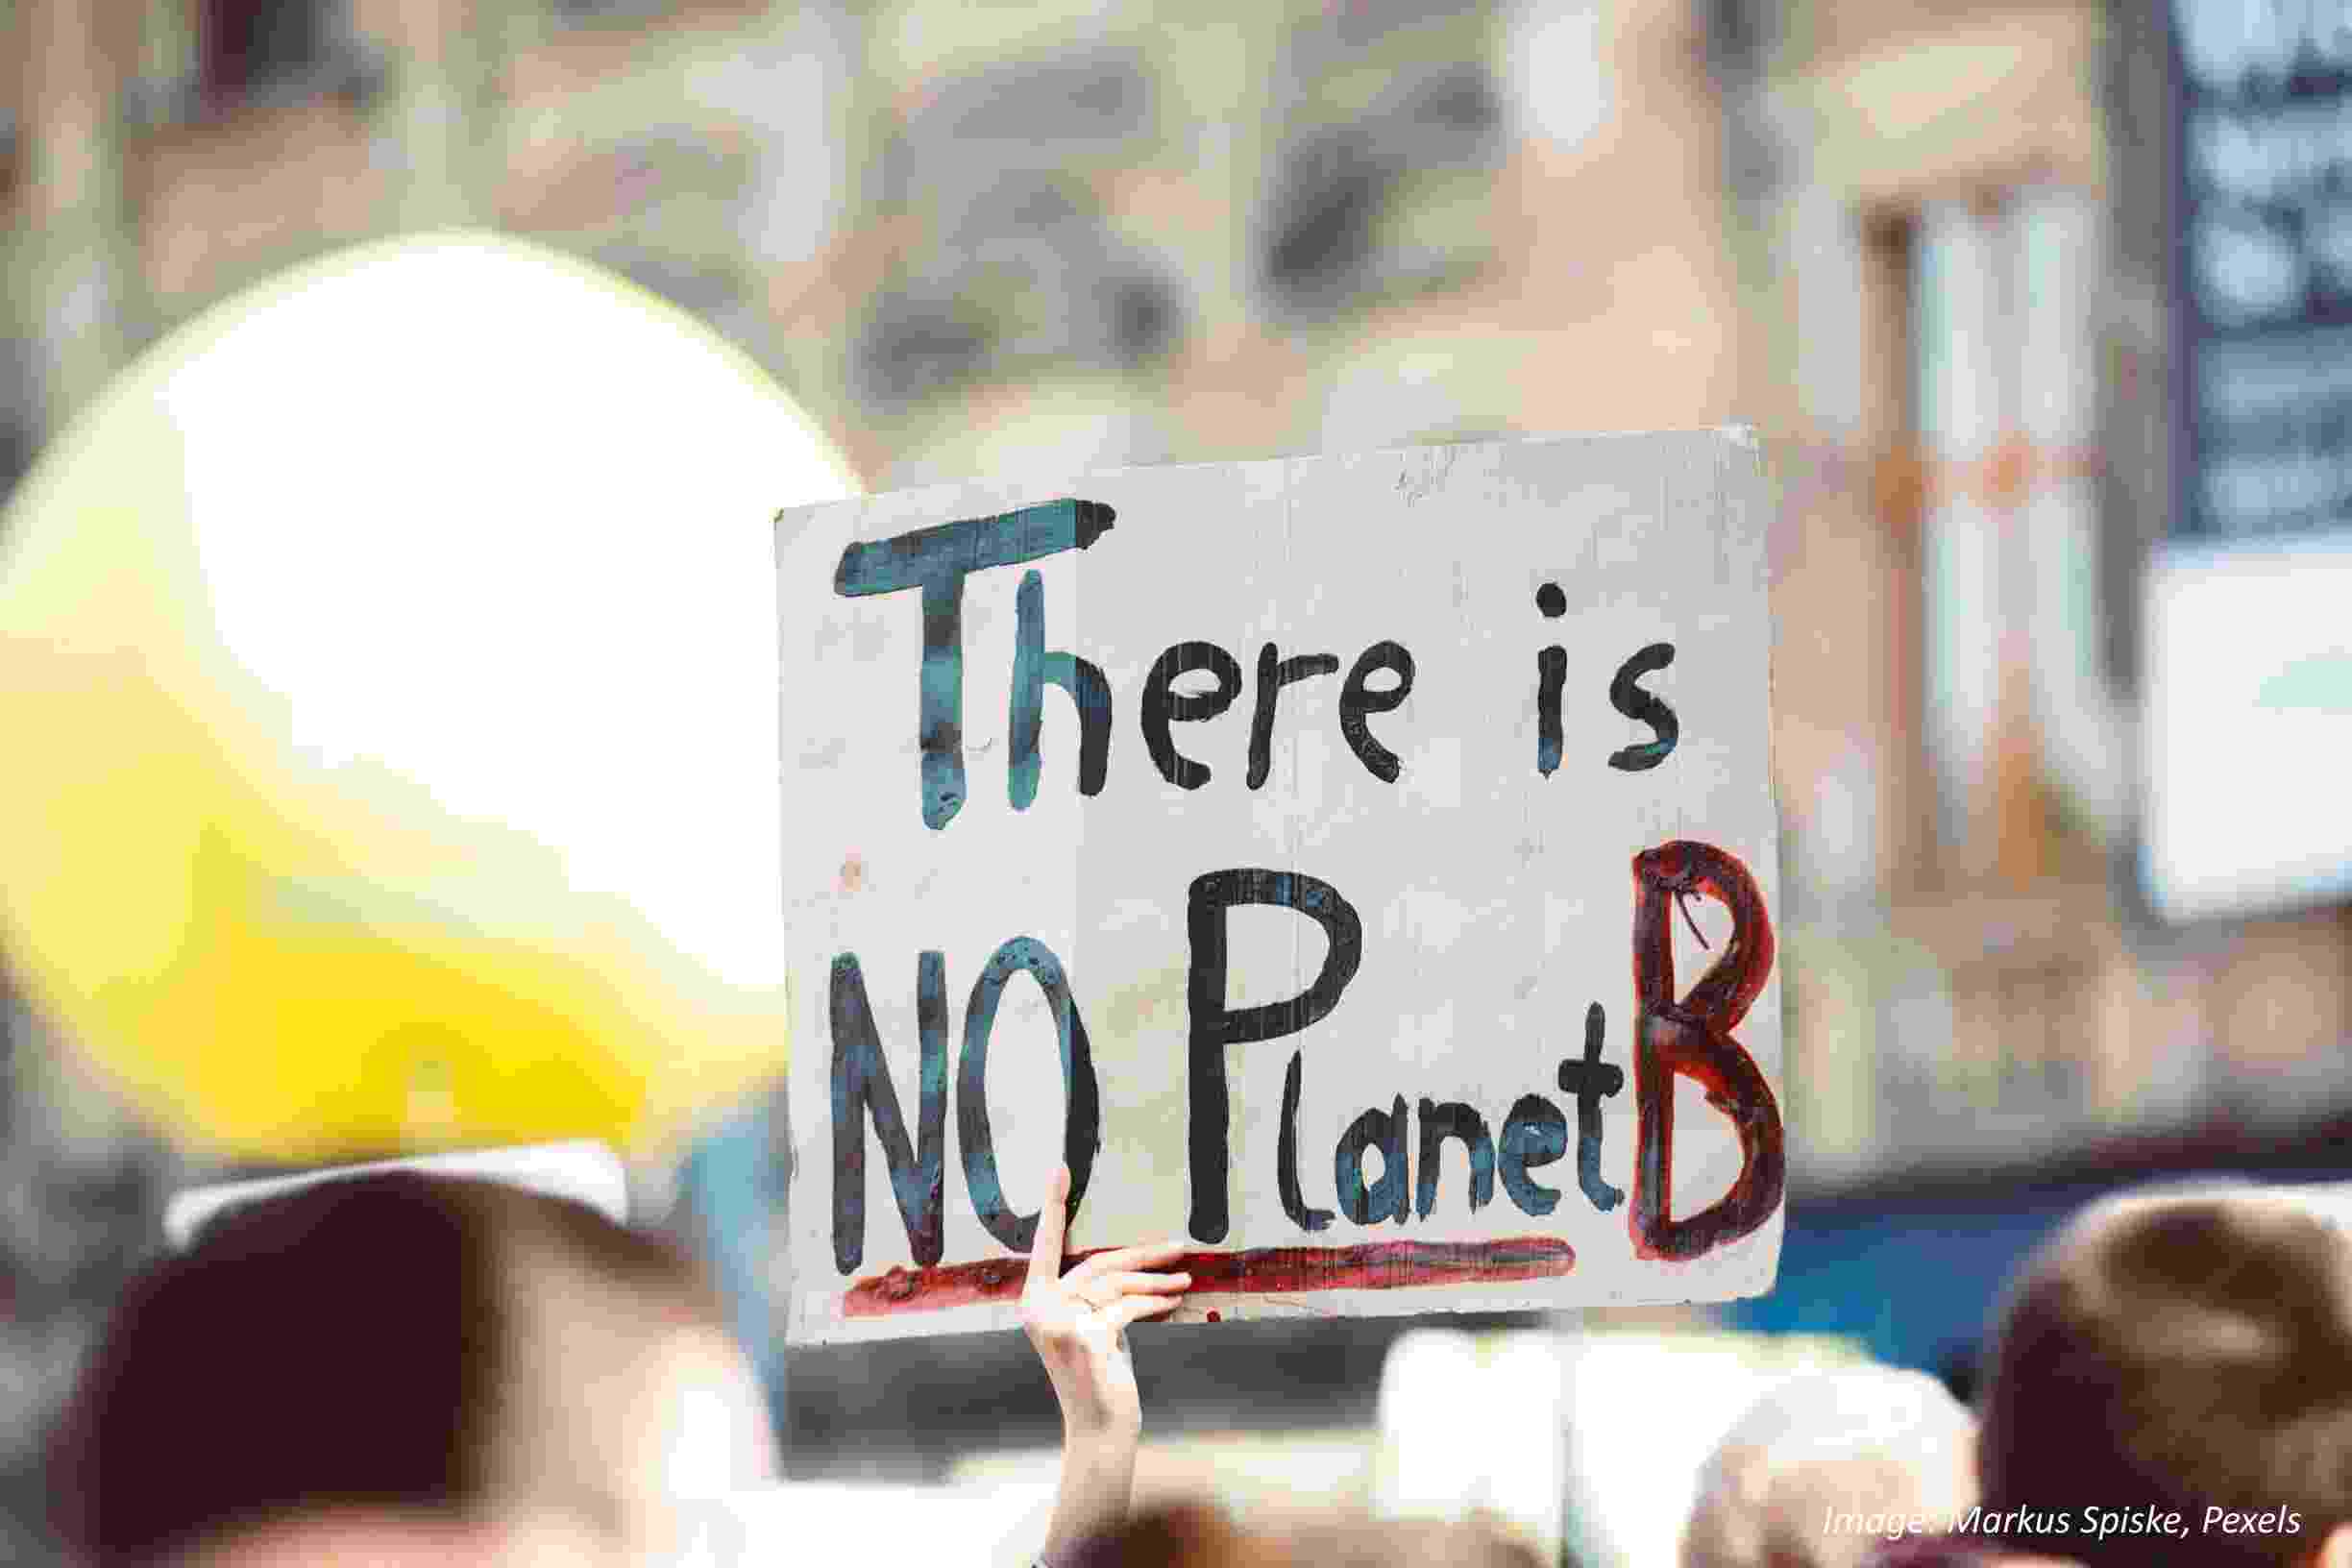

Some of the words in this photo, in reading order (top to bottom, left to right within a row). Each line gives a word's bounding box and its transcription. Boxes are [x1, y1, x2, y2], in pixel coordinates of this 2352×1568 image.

[834, 498, 1416, 831] There
[1537, 581, 1679, 780] is
[829, 936, 1101, 1275] NO
[1629, 839, 1786, 1262] B
